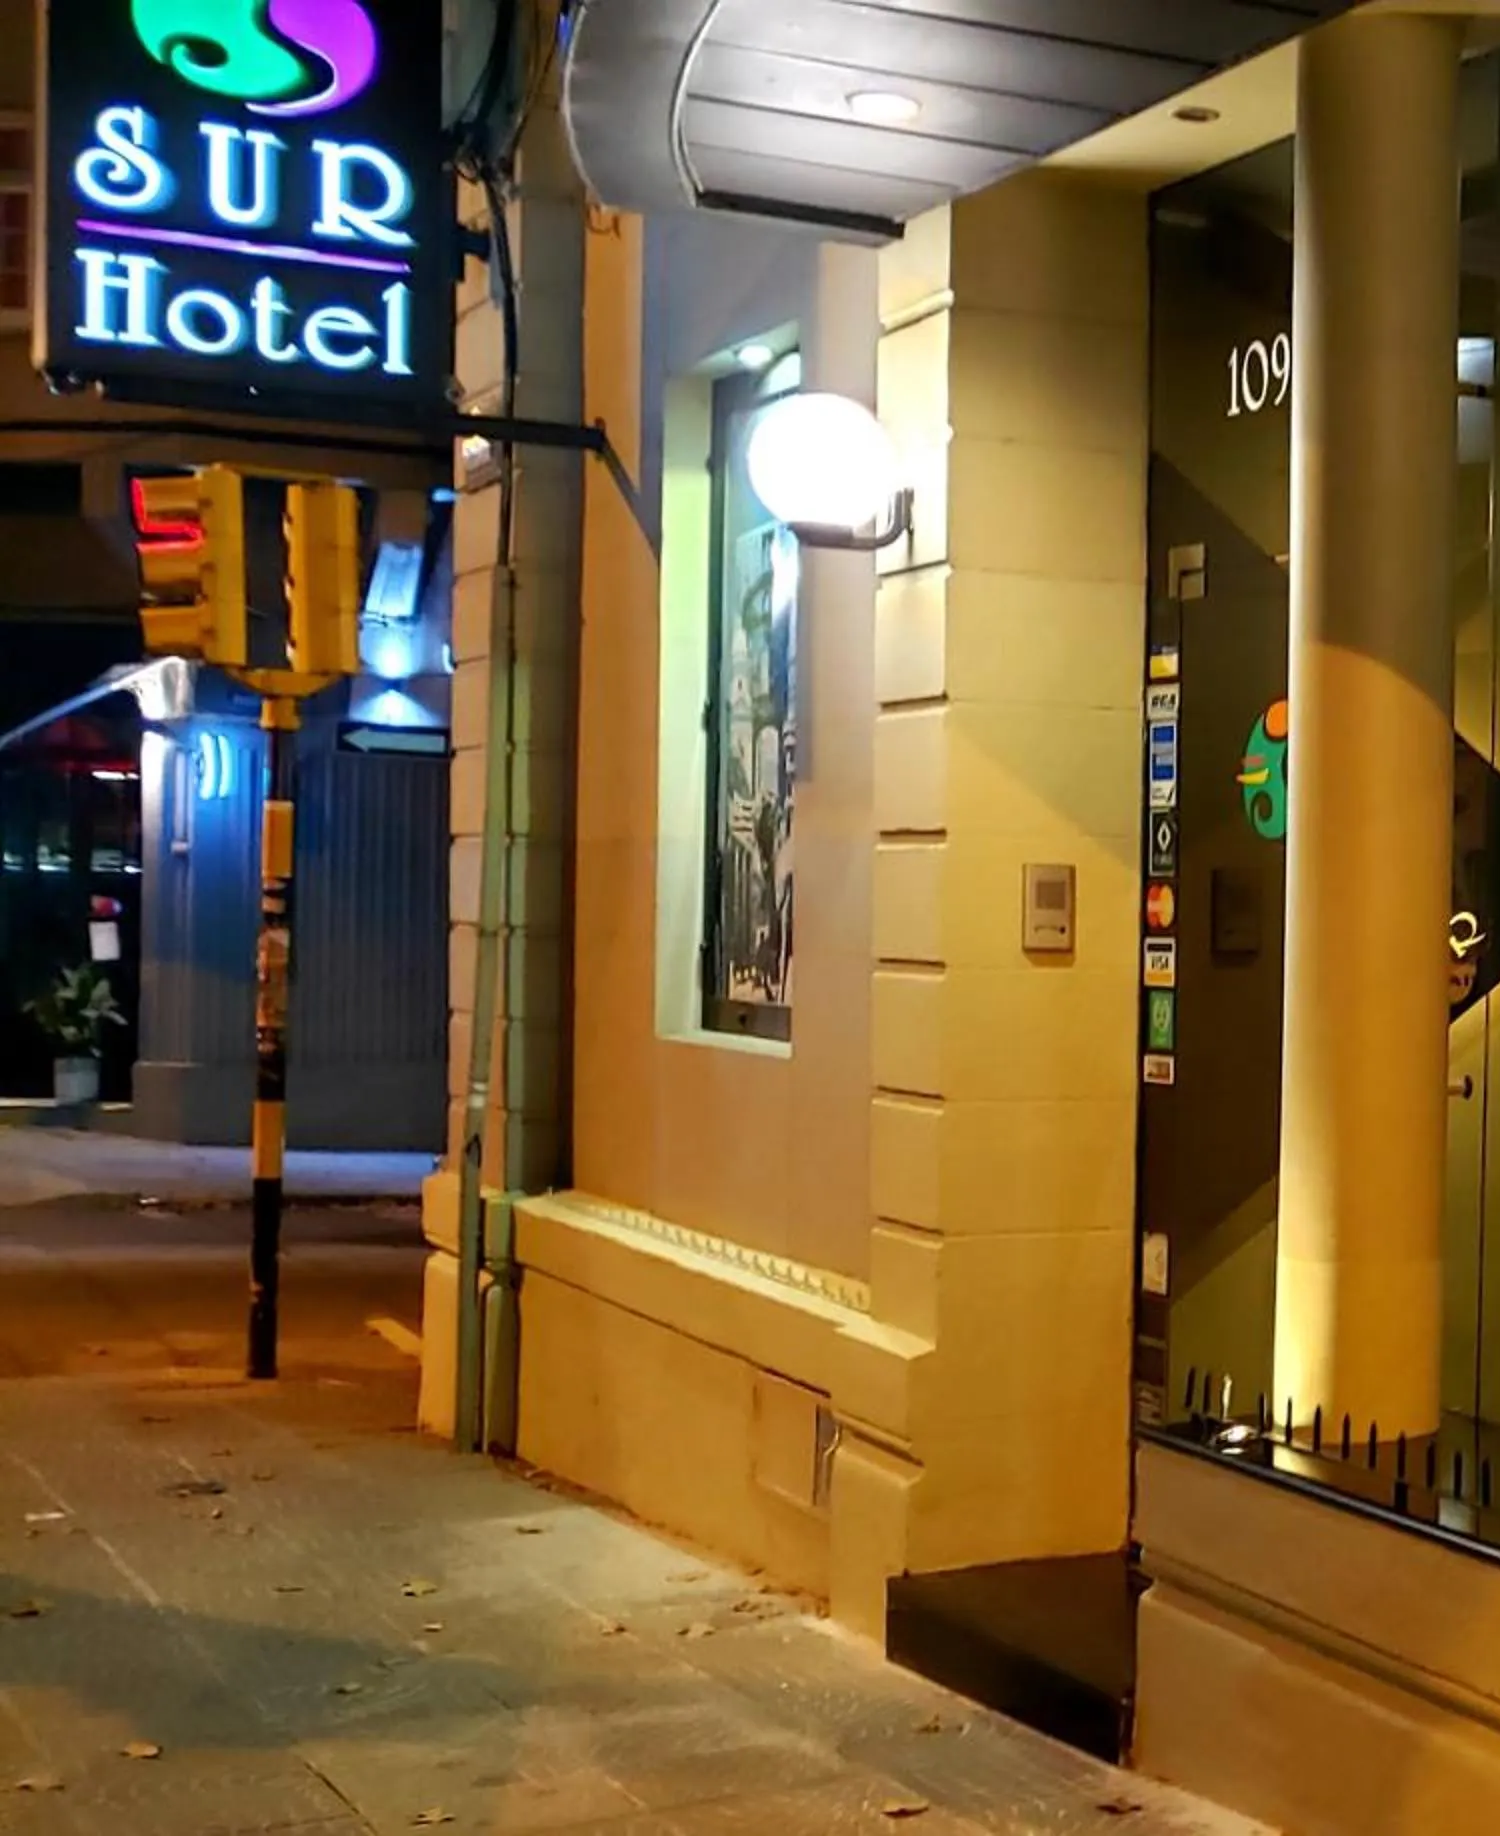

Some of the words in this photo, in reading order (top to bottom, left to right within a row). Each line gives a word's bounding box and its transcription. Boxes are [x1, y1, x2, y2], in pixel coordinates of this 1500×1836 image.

[74, 105, 416, 247] SUR
[74, 248, 415, 375] Hotel
[1227, 332, 1291, 417] 109
